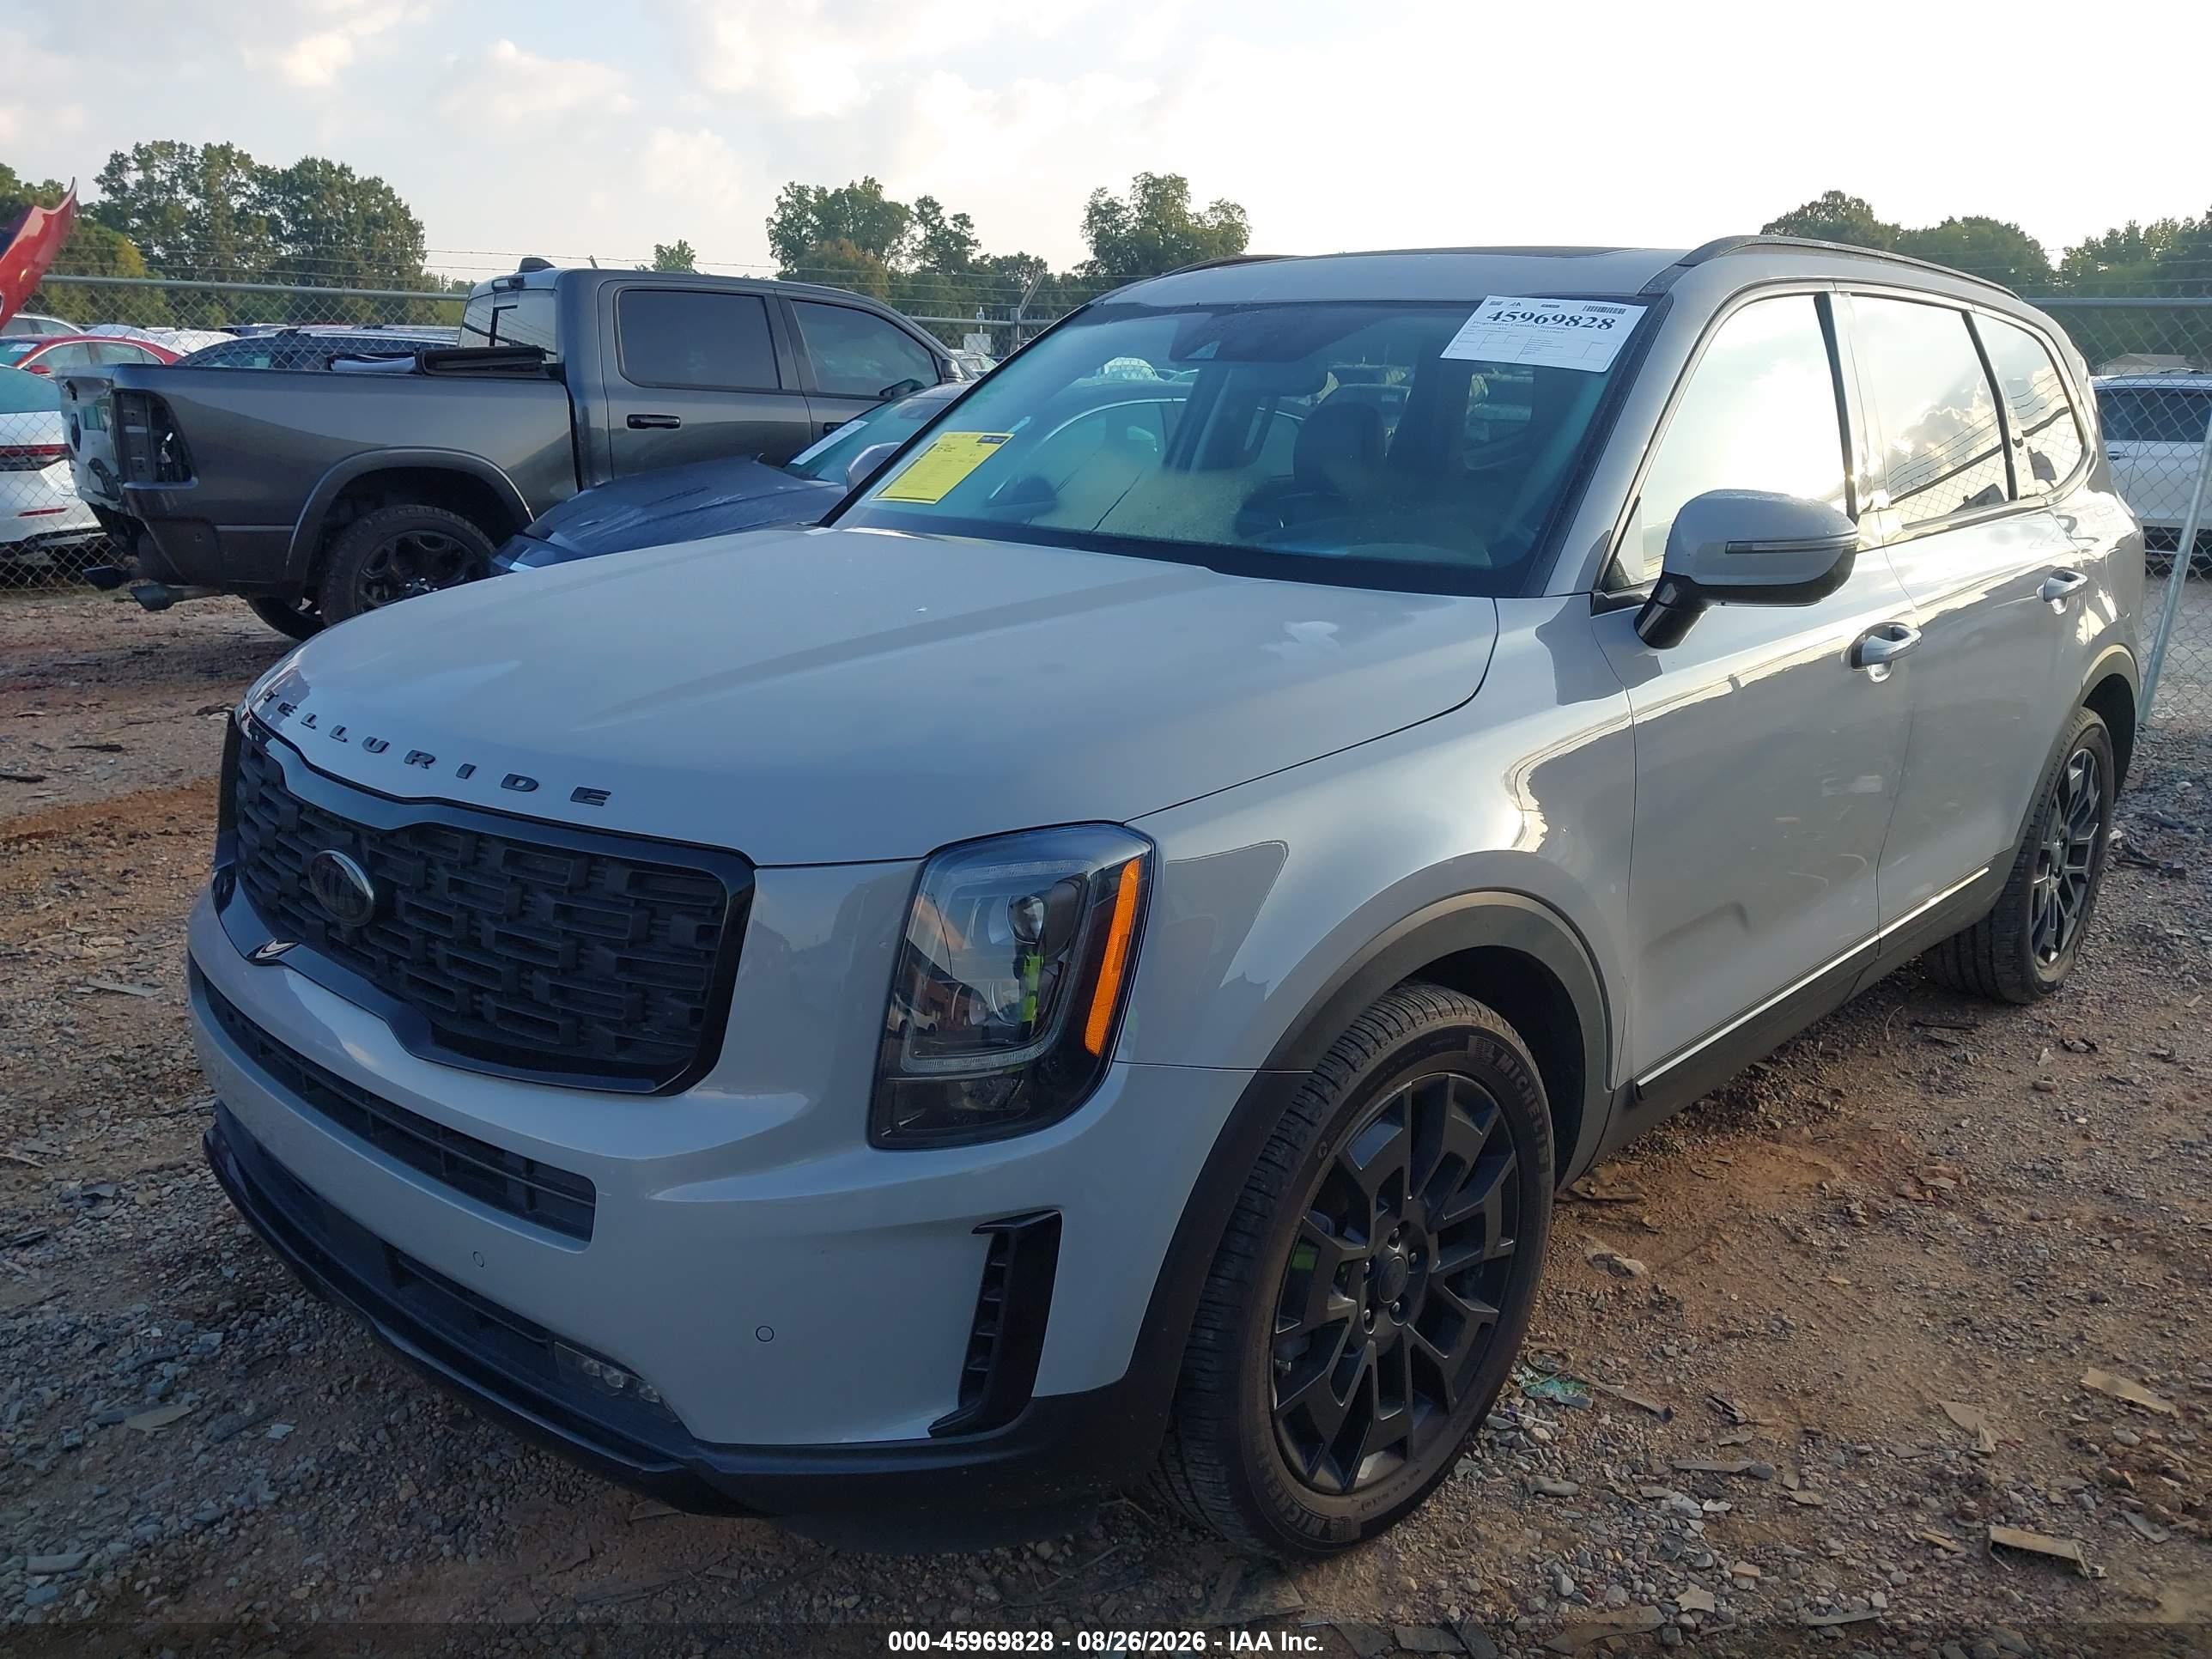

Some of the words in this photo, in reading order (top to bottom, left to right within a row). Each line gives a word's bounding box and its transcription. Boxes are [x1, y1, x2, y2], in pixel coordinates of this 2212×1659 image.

[1486, 310, 1616, 331] 45969828
[264, 690, 612, 806] TELLURIDE
[1495, 1052, 1551, 1174] MICHELIN
